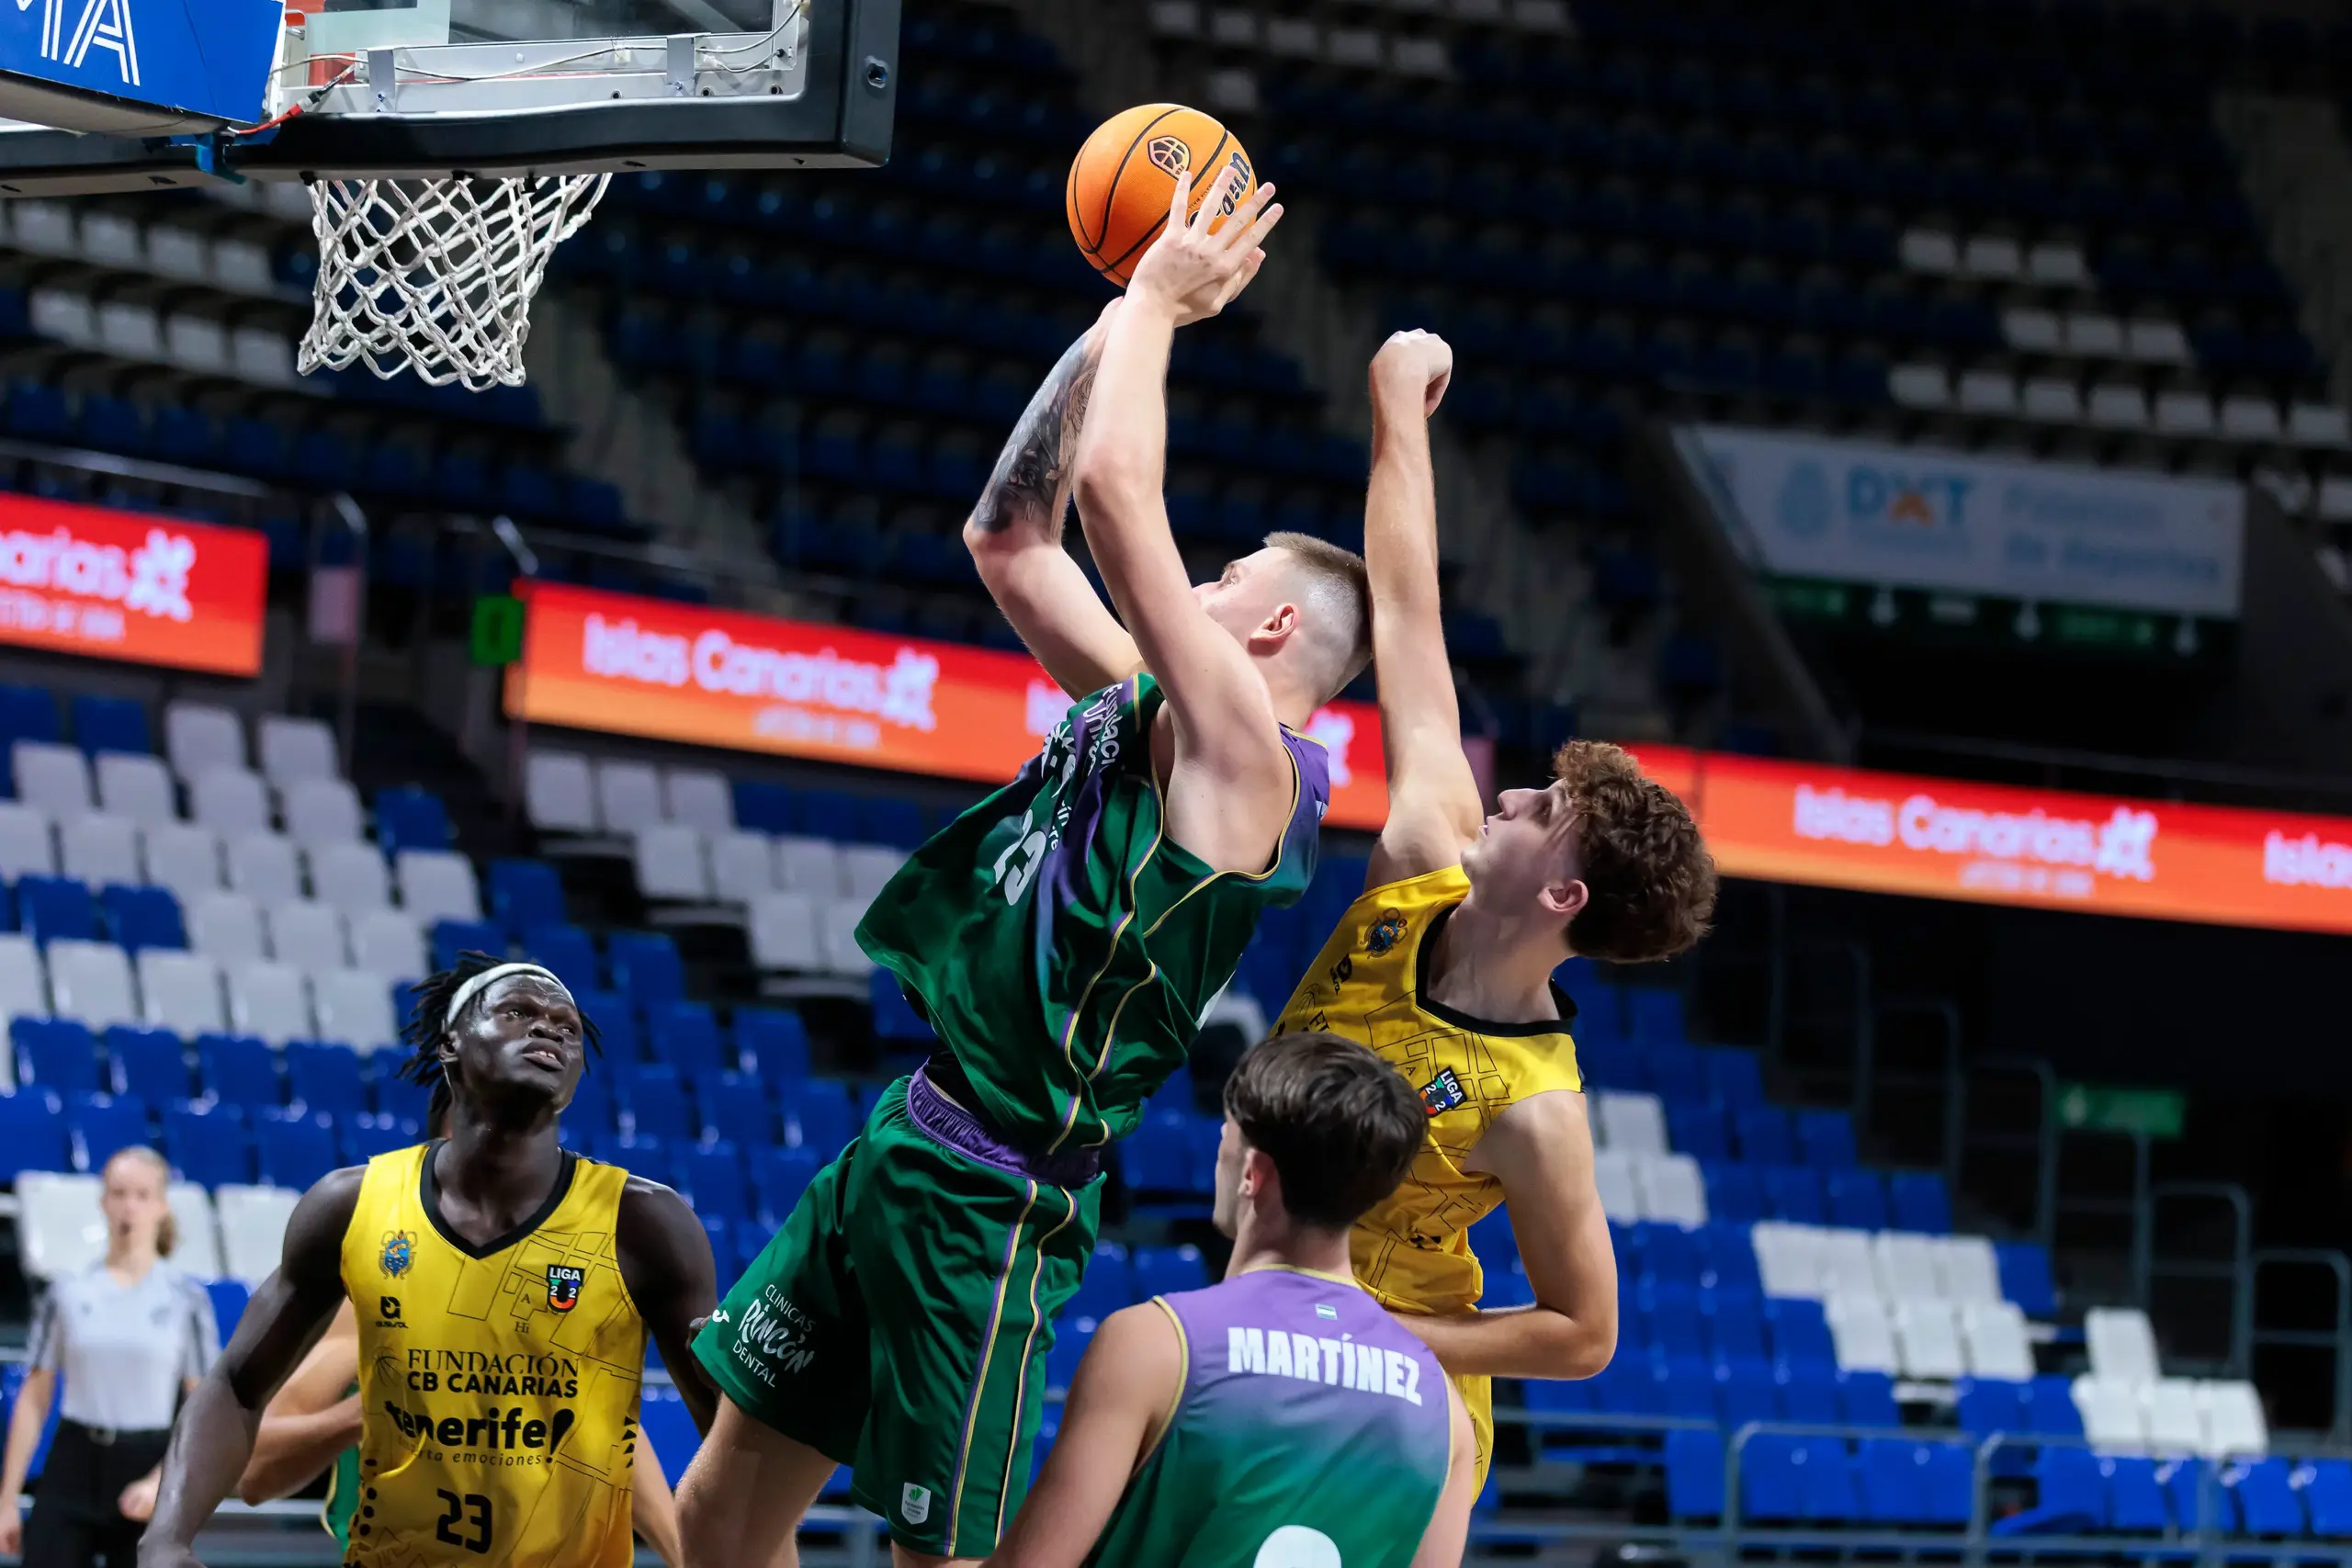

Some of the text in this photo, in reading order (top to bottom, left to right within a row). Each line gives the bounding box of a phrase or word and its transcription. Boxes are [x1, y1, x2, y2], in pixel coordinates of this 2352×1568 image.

[0, 525, 128, 600] arias
[583, 613, 880, 713] Islas Canarias
[1102, 683, 1123, 773] Fundaci
[1794, 784, 2093, 865] Islas Canarias
[2264, 829, 2352, 888] Isla
[1440, 1070, 1463, 1103] LIGA
[549, 1268, 581, 1280] LIGA
[407, 1348, 580, 1379] FUNDACIÓN
[407, 1371, 579, 1399] CB CANARIAS
[732, 1339, 775, 1388] DENTAL
[1227, 1326, 1422, 1406] MARTÍNEZ
[452, 1451, 543, 1467] emociones
[436, 1487, 492, 1554] 23
